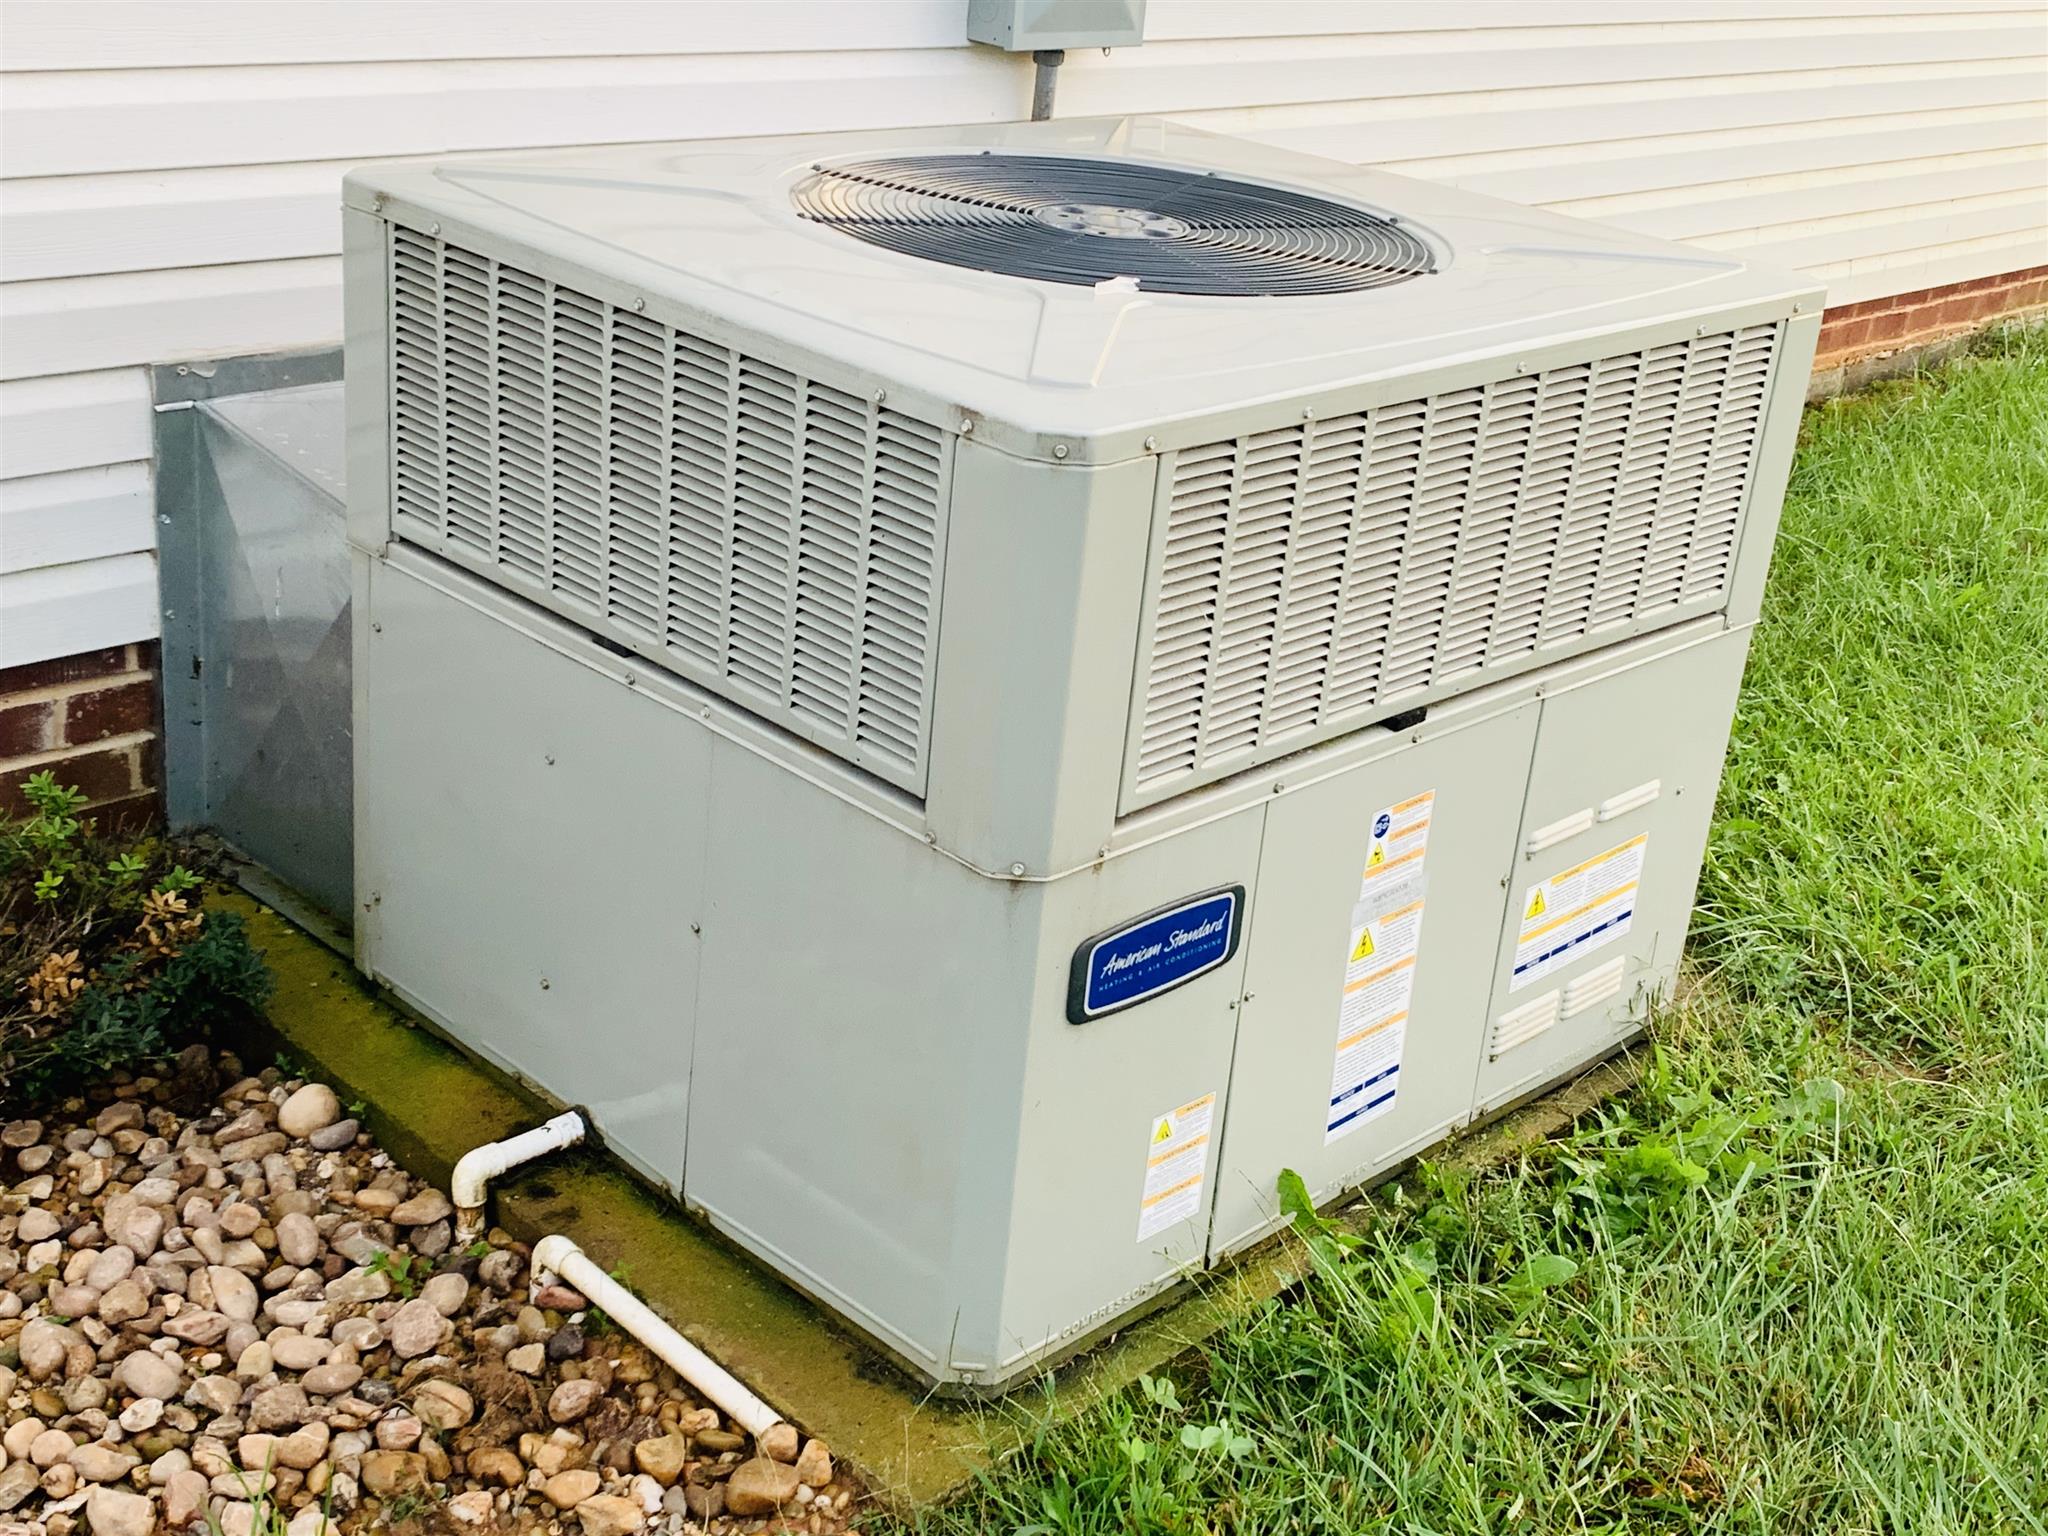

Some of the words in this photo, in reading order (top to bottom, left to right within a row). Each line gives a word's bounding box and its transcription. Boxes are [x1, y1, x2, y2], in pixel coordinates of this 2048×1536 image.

[1099, 973, 1133, 992] HEATING
[1148, 963, 1160, 972] AIR
[1165, 938, 1222, 966] CONDITIONING
[1100, 943, 1162, 979] American
[1164, 910, 1228, 952] Standard
